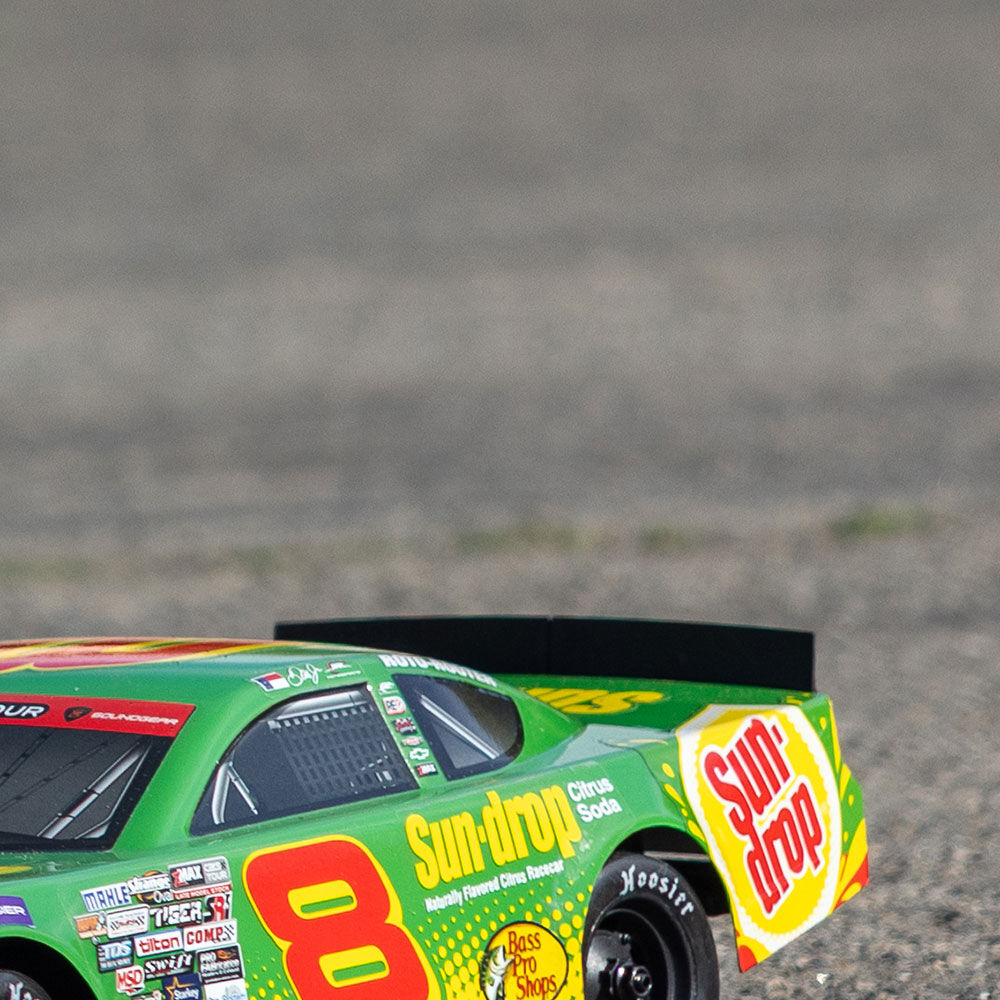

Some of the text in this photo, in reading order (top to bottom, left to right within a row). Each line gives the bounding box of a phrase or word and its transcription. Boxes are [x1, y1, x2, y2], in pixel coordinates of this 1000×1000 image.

[91, 712, 179, 726] SOUNDGEAR
[567, 777, 614, 802] Citrus
[576, 797, 623, 823] Soda
[746, 782, 823, 915] drop
[424, 859, 564, 912] Naturally Flavored Citrus Racecar
[619, 864, 694, 915] Hoosier
[83, 886, 130, 912] MAHLE
[139, 936, 180, 953] tilton
[187, 927, 223, 945] COMP
[508, 931, 541, 954] Bass
[512, 954, 537, 976] Pro
[516, 975, 557, 1000] Shops
